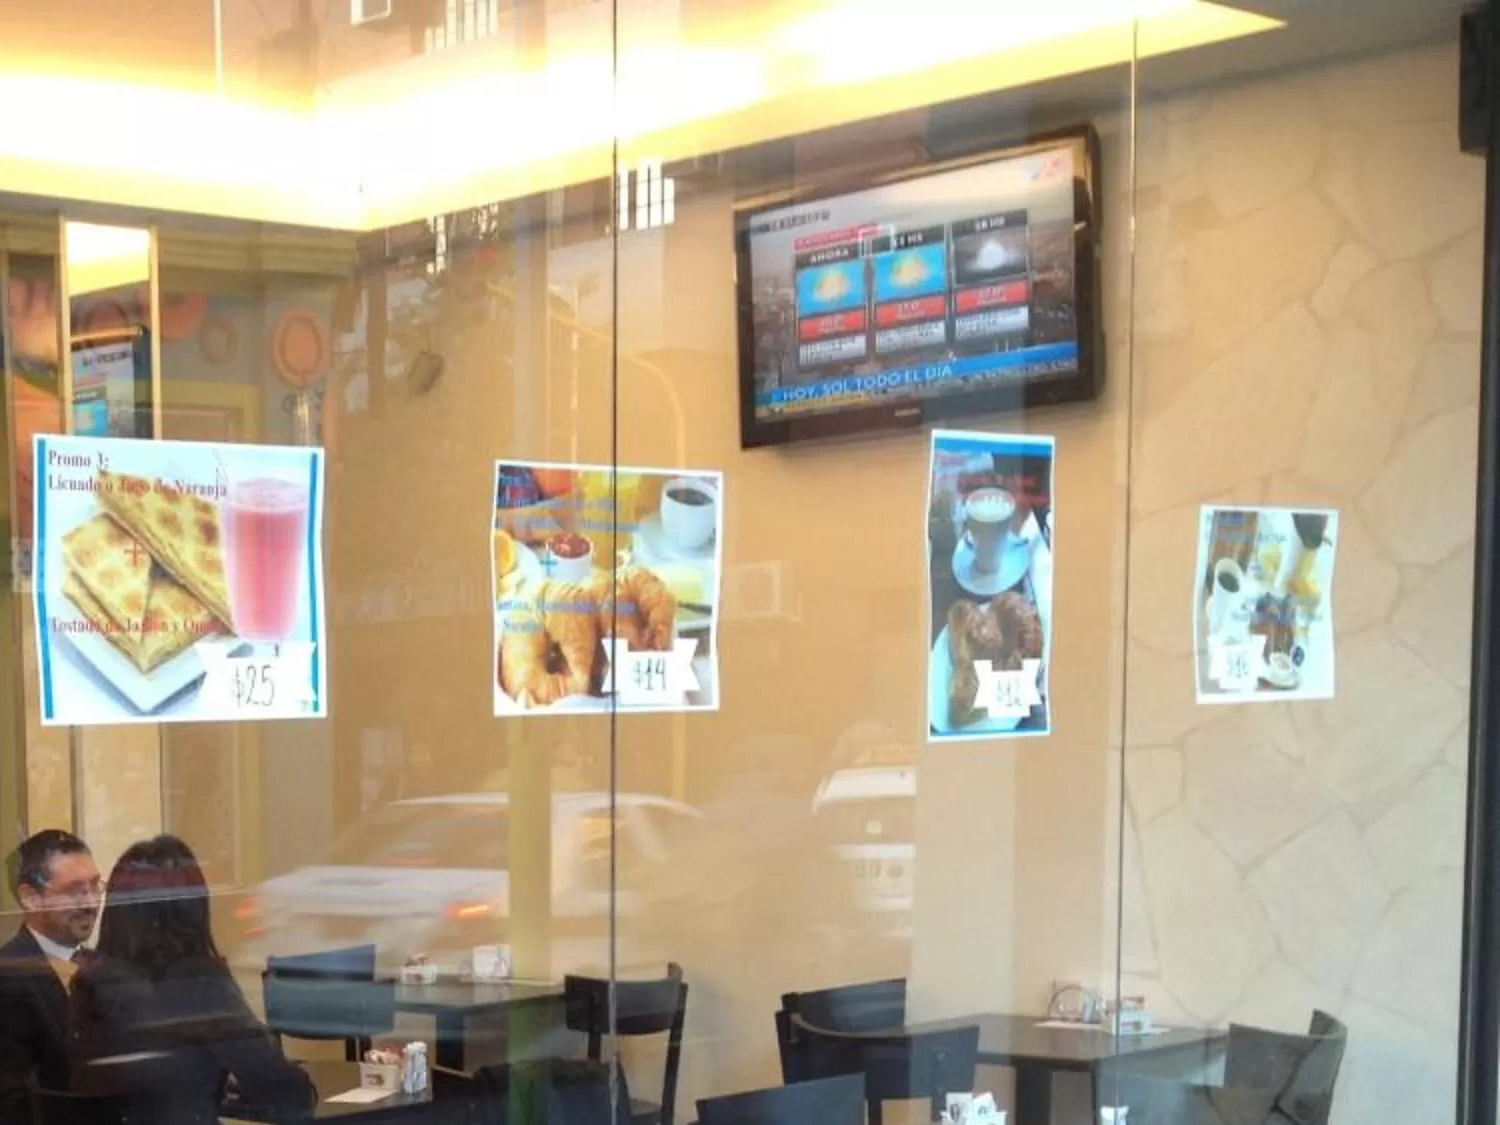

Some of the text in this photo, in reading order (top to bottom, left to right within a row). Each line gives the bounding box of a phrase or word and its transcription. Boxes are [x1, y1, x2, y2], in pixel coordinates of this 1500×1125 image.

[809, 247, 849, 263] AHORA
[854, 373, 900, 391] TODO
[48, 449, 91, 467] Promo
[48, 474, 101, 493] Licuado
[174, 478, 227, 501] Naranja
[126, 616, 169, 634] Jan
[231, 663, 275, 708] $25
